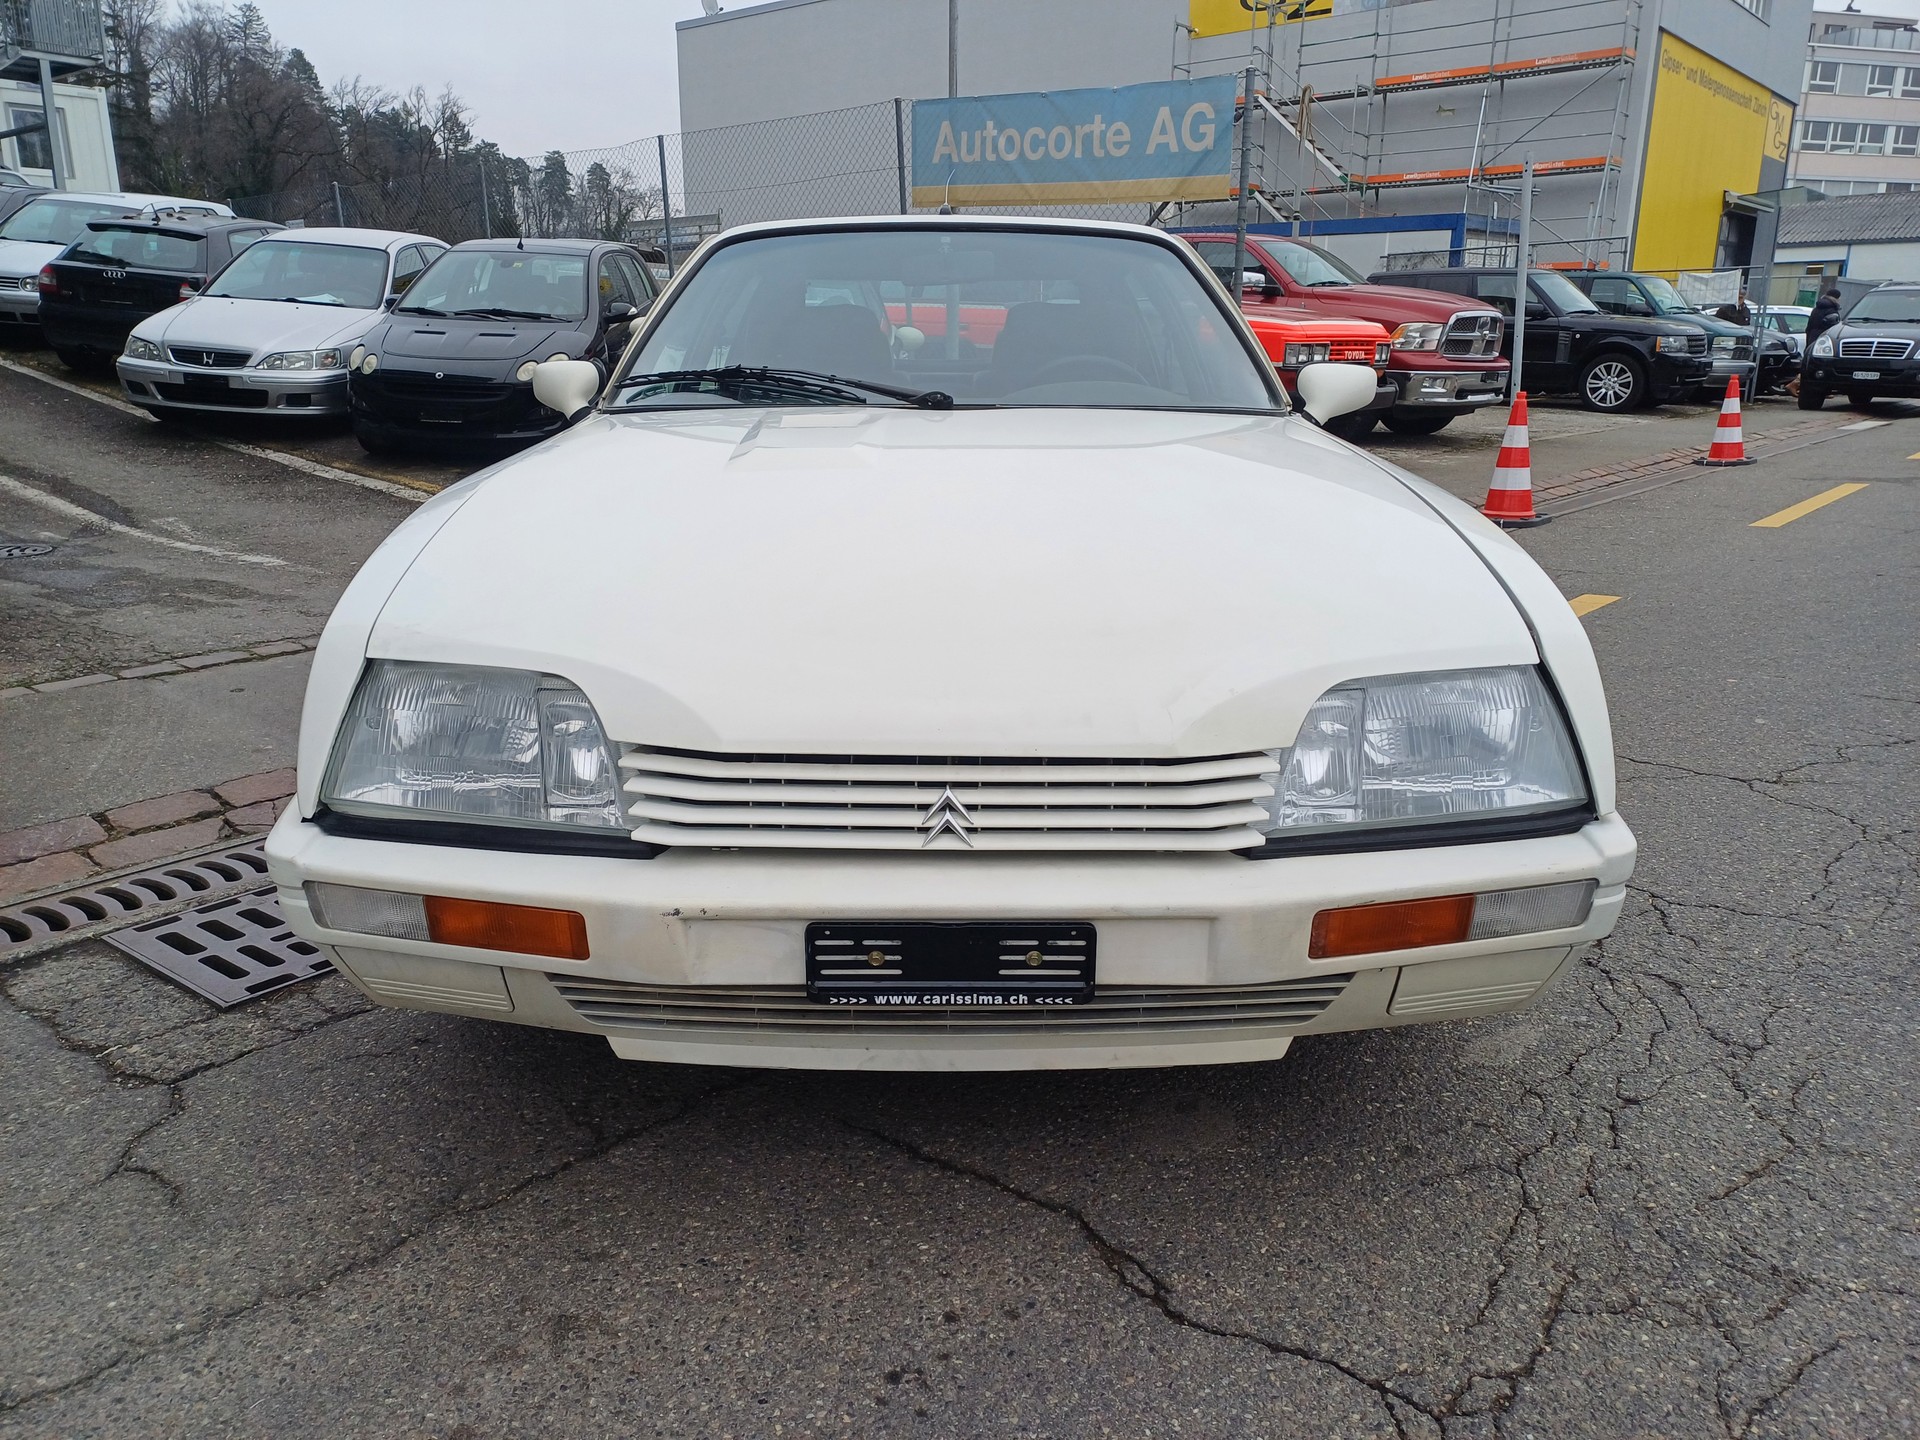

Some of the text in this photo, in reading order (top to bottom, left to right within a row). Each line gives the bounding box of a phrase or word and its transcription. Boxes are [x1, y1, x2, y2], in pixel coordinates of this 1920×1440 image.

[932, 102, 1216, 164] Autocorte AG
[1344, 350, 1365, 360] TOYOTA
[874, 993, 1029, 1005] www.carissima.ch
